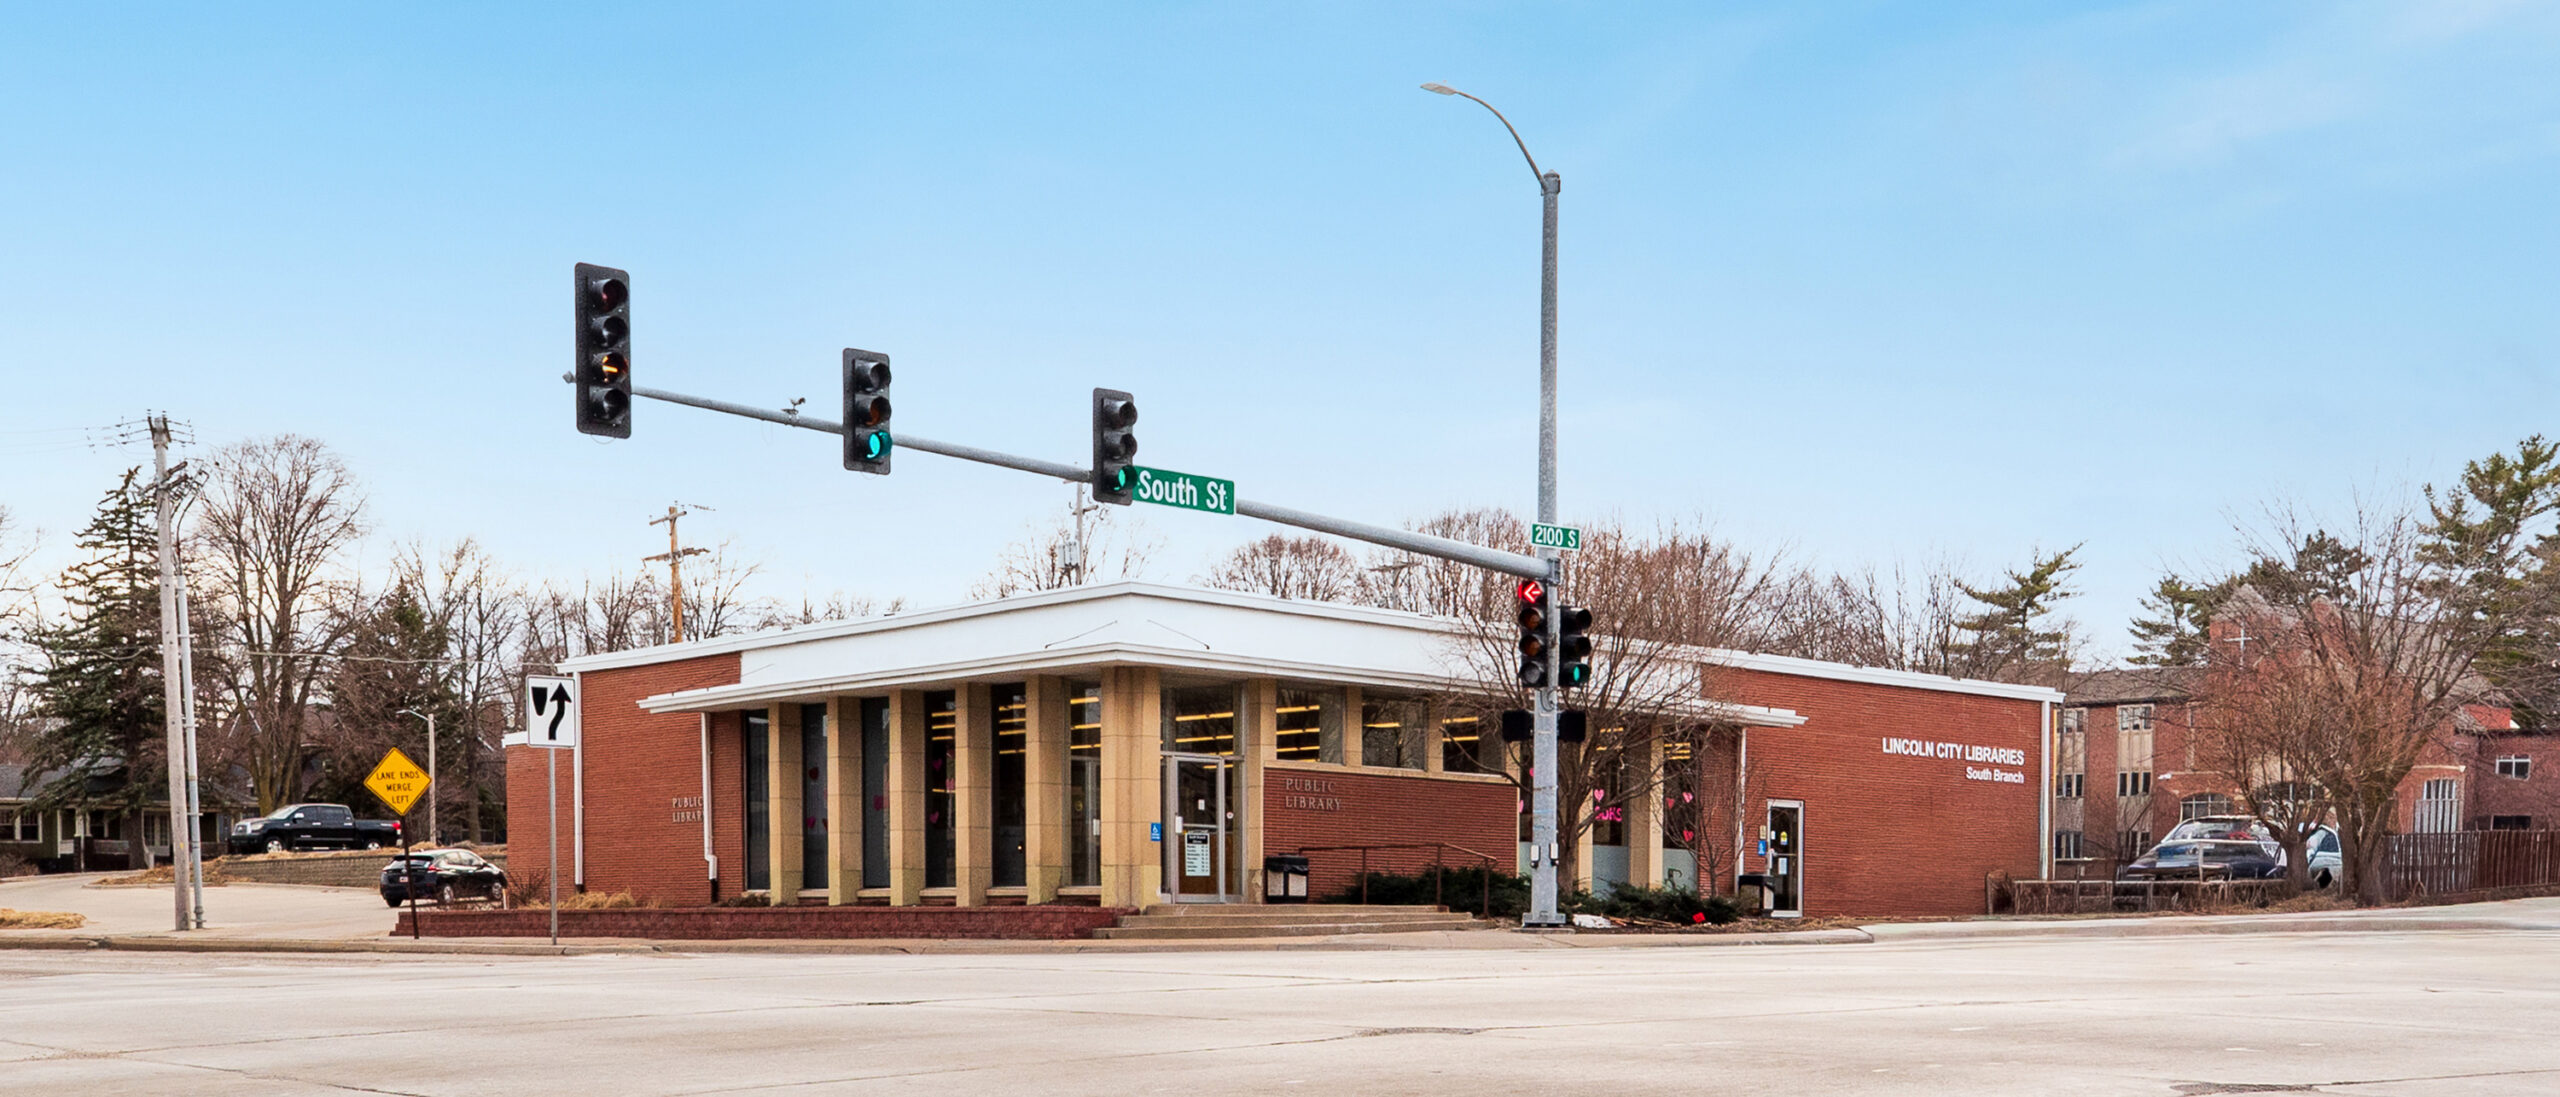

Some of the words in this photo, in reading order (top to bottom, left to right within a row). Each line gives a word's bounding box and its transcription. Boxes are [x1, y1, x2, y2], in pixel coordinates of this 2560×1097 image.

[1138, 470, 1197, 506] South
[1206, 481, 1226, 511] St
[1535, 526, 1563, 546] 2100
[1568, 530, 1576, 547] S
[1882, 737, 1934, 757] LINCOLN
[1936, 742, 1963, 759] CITY
[1965, 745, 2024, 766] LIBRARIES
[376, 771, 396, 780] LANE
[400, 771, 420, 779] ENDS
[1966, 766, 1992, 781] South
[1993, 769, 2024, 784] Branch
[386, 783, 413, 792] MERGE
[1286, 778, 1336, 793] PUBLIC
[392, 795, 409, 804] LEFT
[672, 796, 703, 808] PUBLIC
[1285, 795, 1341, 810] LIBRARY
[672, 811, 703, 823] LIBRAR
